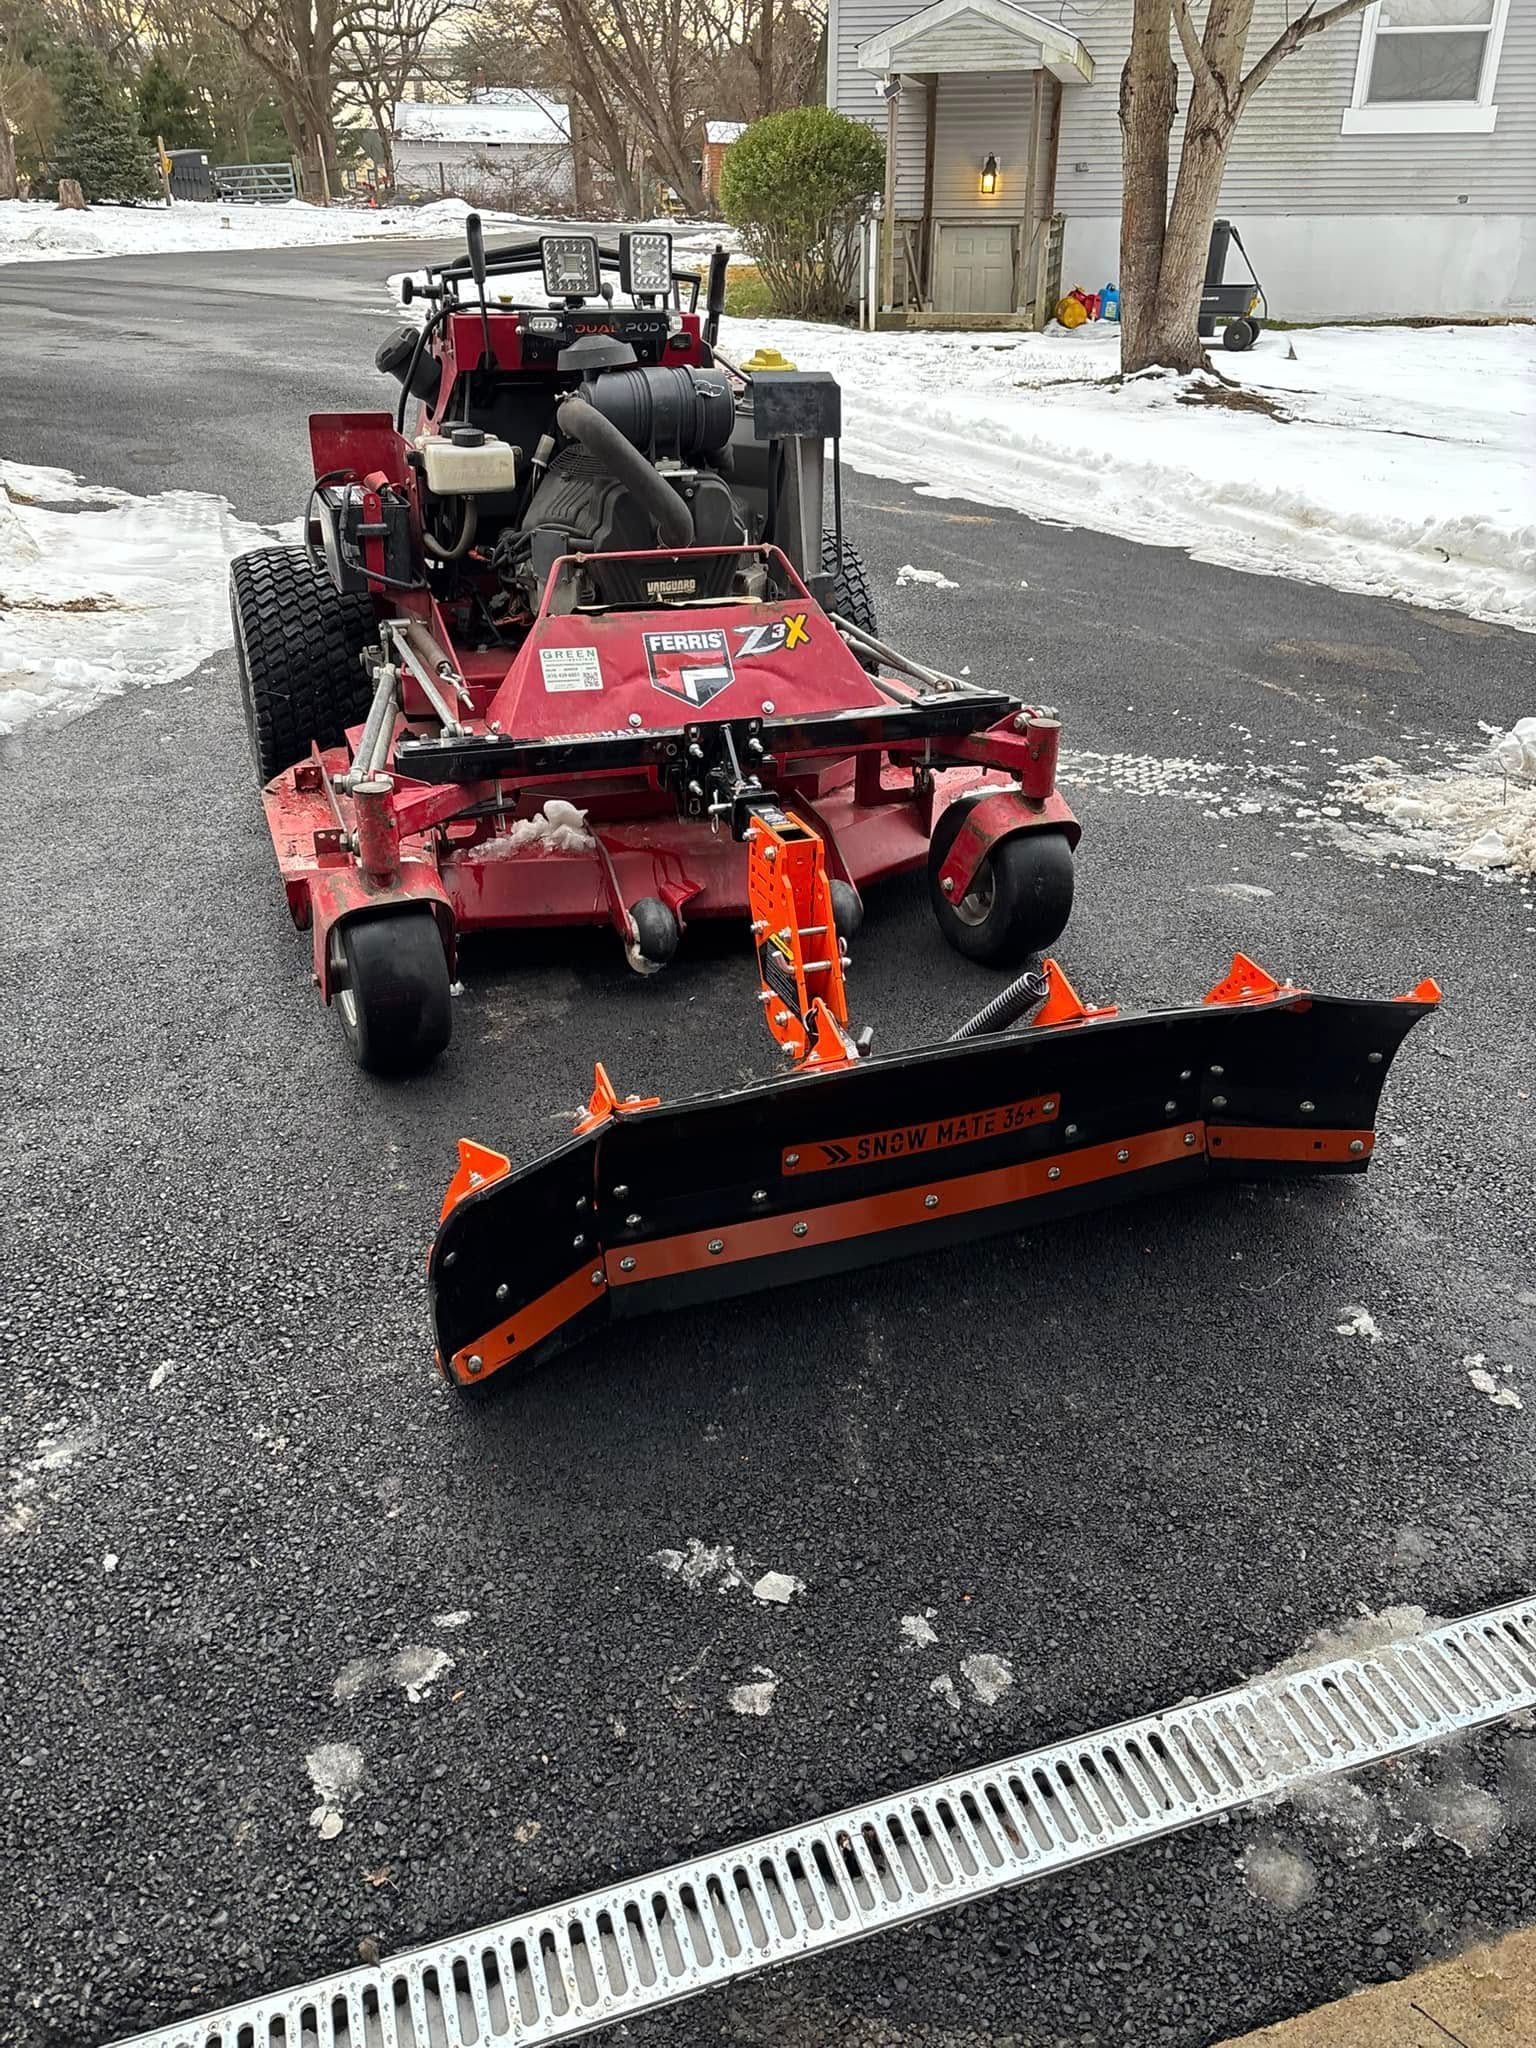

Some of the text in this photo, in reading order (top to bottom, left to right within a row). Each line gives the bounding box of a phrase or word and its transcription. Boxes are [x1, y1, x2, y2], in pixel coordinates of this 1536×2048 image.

[575, 322, 660, 333] DUAL POD
[647, 579, 696, 591] VANGUARD
[650, 633, 722, 651] FERRIS
[542, 649, 595, 659] GREEN
[857, 1105, 1037, 1160] SNOW MATE 36+
